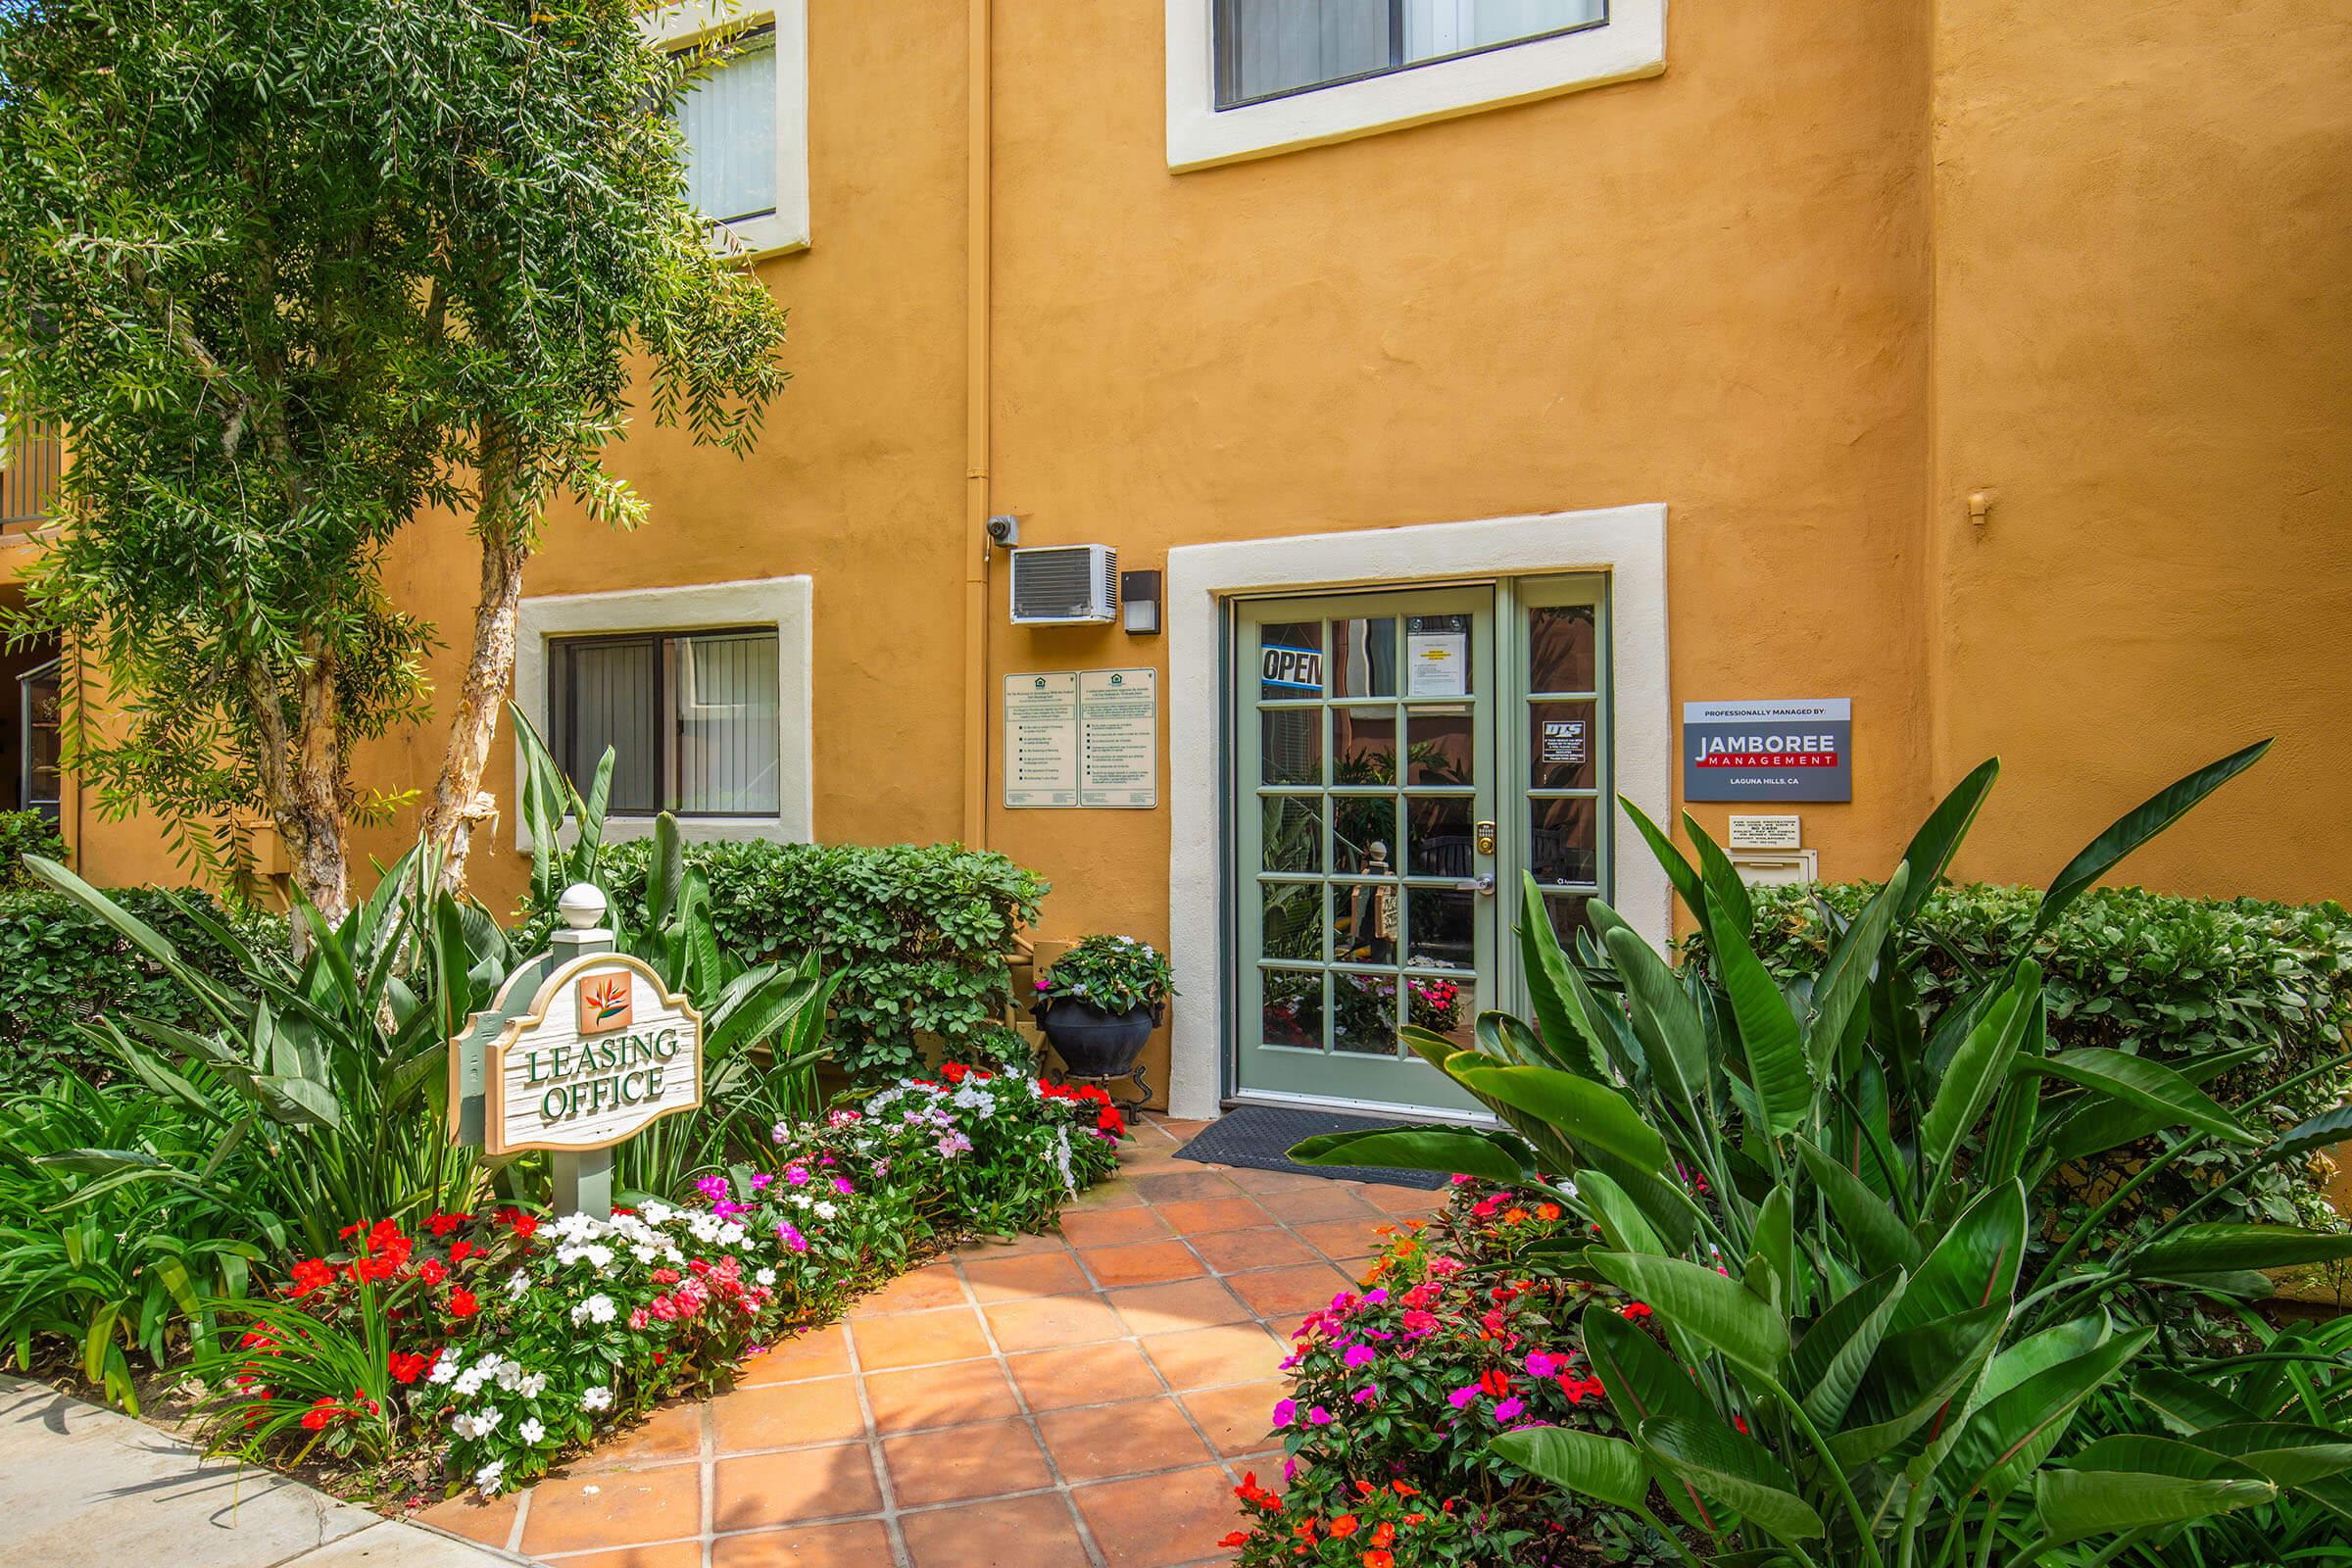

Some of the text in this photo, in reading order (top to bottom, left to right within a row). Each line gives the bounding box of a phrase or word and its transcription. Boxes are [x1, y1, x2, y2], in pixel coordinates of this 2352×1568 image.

[1263, 650, 1322, 685] OPEN
[1694, 735, 1835, 761] JAMBOREE
[1709, 756, 1833, 765] MANAGEMENT
[527, 1028, 678, 1083] LEASING
[543, 1066, 665, 1118] OFFICE
